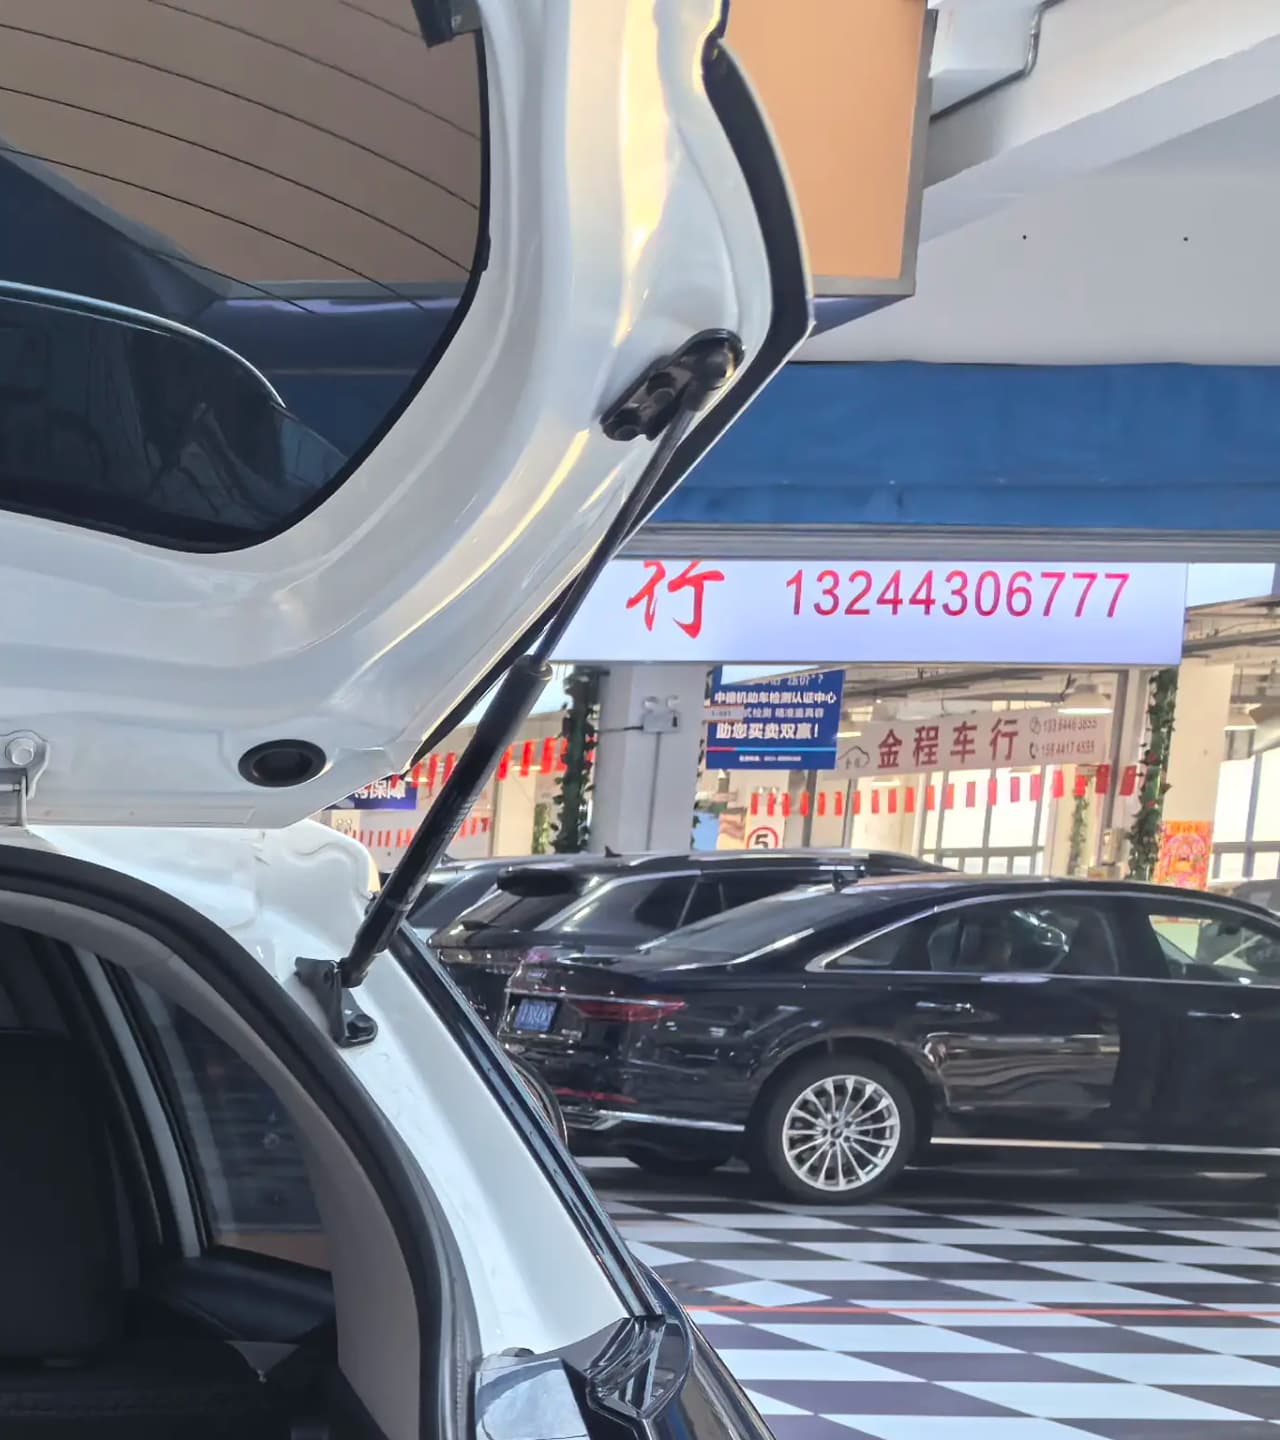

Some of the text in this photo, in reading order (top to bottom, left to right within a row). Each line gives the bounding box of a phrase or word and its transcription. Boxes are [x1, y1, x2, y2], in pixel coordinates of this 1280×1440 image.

[626, 560, 1131, 639] 行 13244306777
[877, 717, 1020, 769] 金程车行
